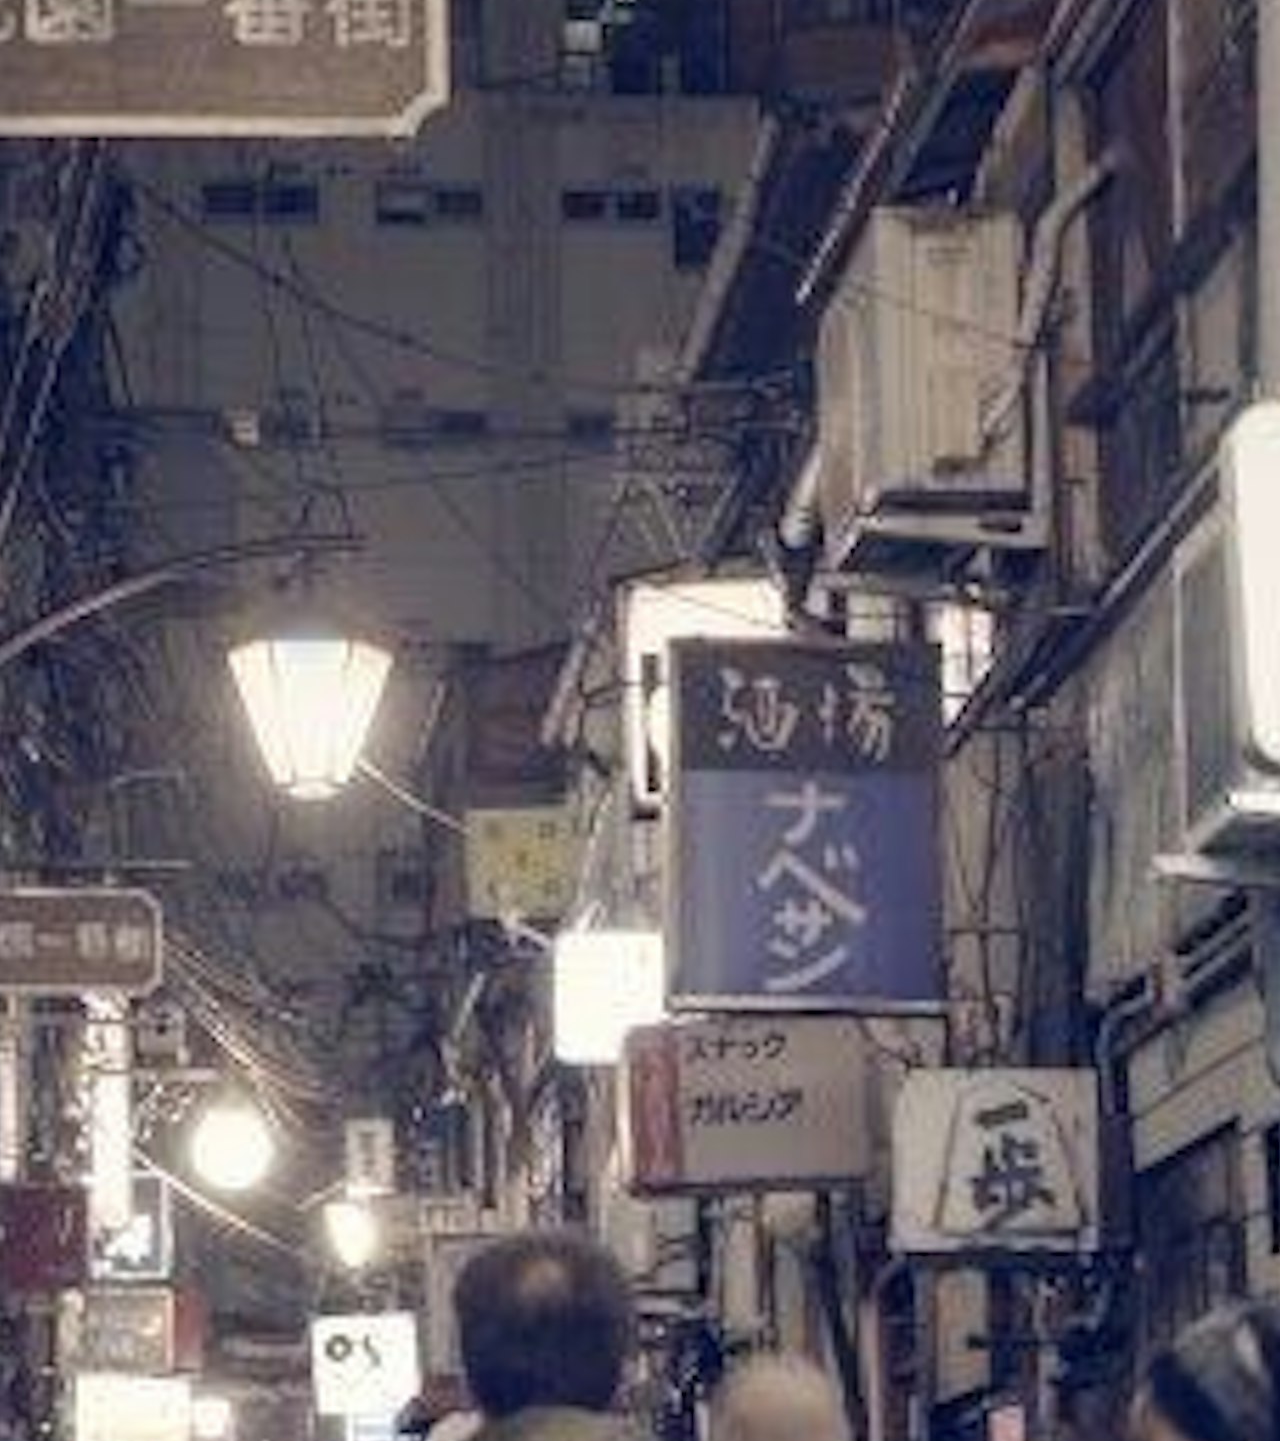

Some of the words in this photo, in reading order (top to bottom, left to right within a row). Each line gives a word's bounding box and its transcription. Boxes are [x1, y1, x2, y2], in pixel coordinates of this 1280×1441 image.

[718, 661, 896, 762] 酒場
[756, 780, 867, 992] ナベサン
[685, 1031, 787, 1063] スナック
